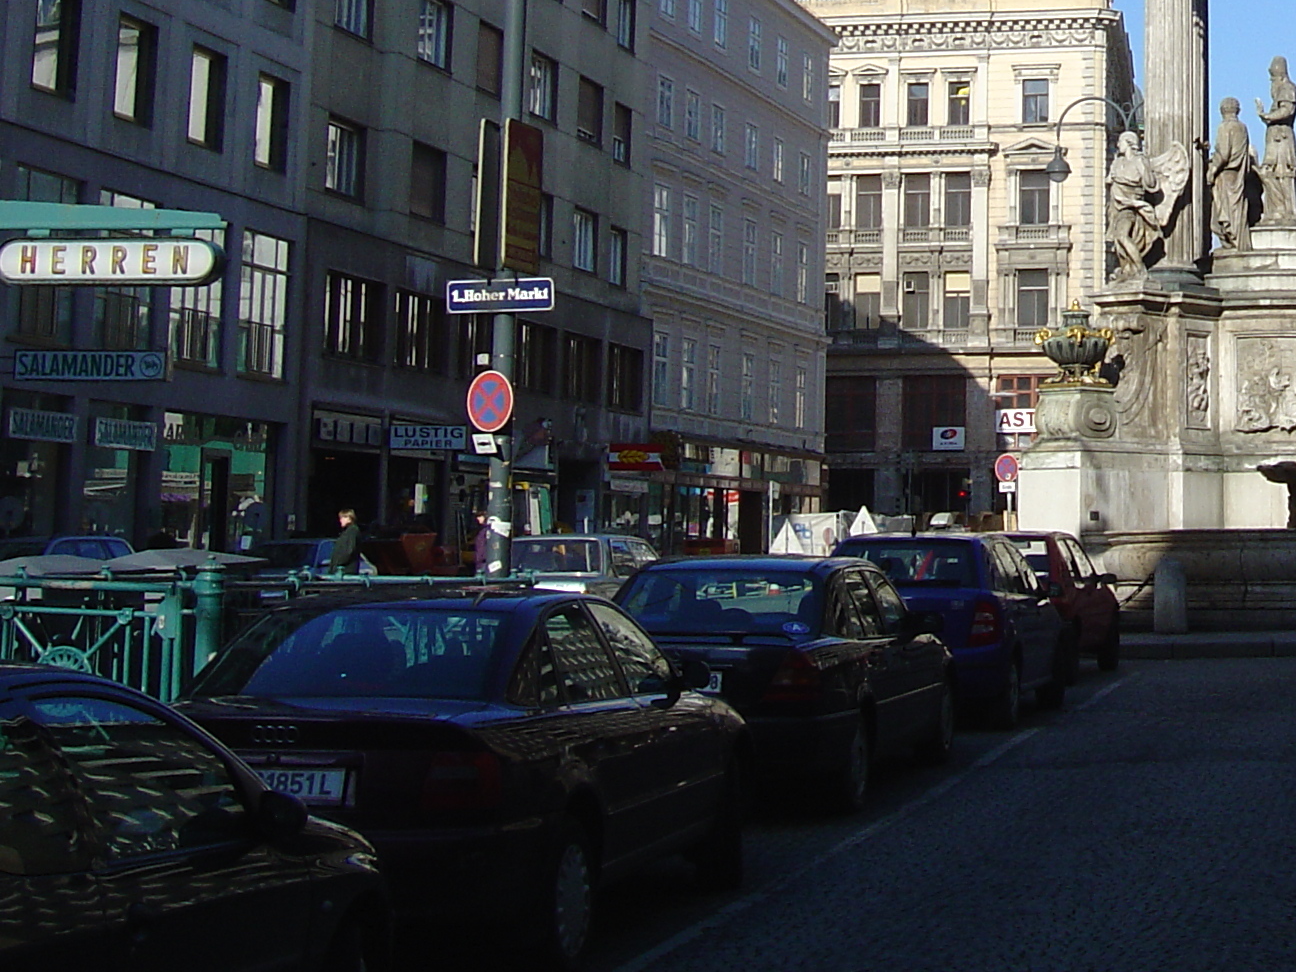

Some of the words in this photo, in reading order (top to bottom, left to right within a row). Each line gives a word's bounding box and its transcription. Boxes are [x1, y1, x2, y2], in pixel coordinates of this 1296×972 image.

[20, 244, 190, 276] HERREN
[464, 289, 506, 302] Hoher
[507, 287, 549, 301] Markt
[18, 353, 136, 377] SALAMANDER
[999, 411, 1036, 428] AST
[394, 427, 464, 439] LUSTIG
[404, 439, 453, 448] PAPIER
